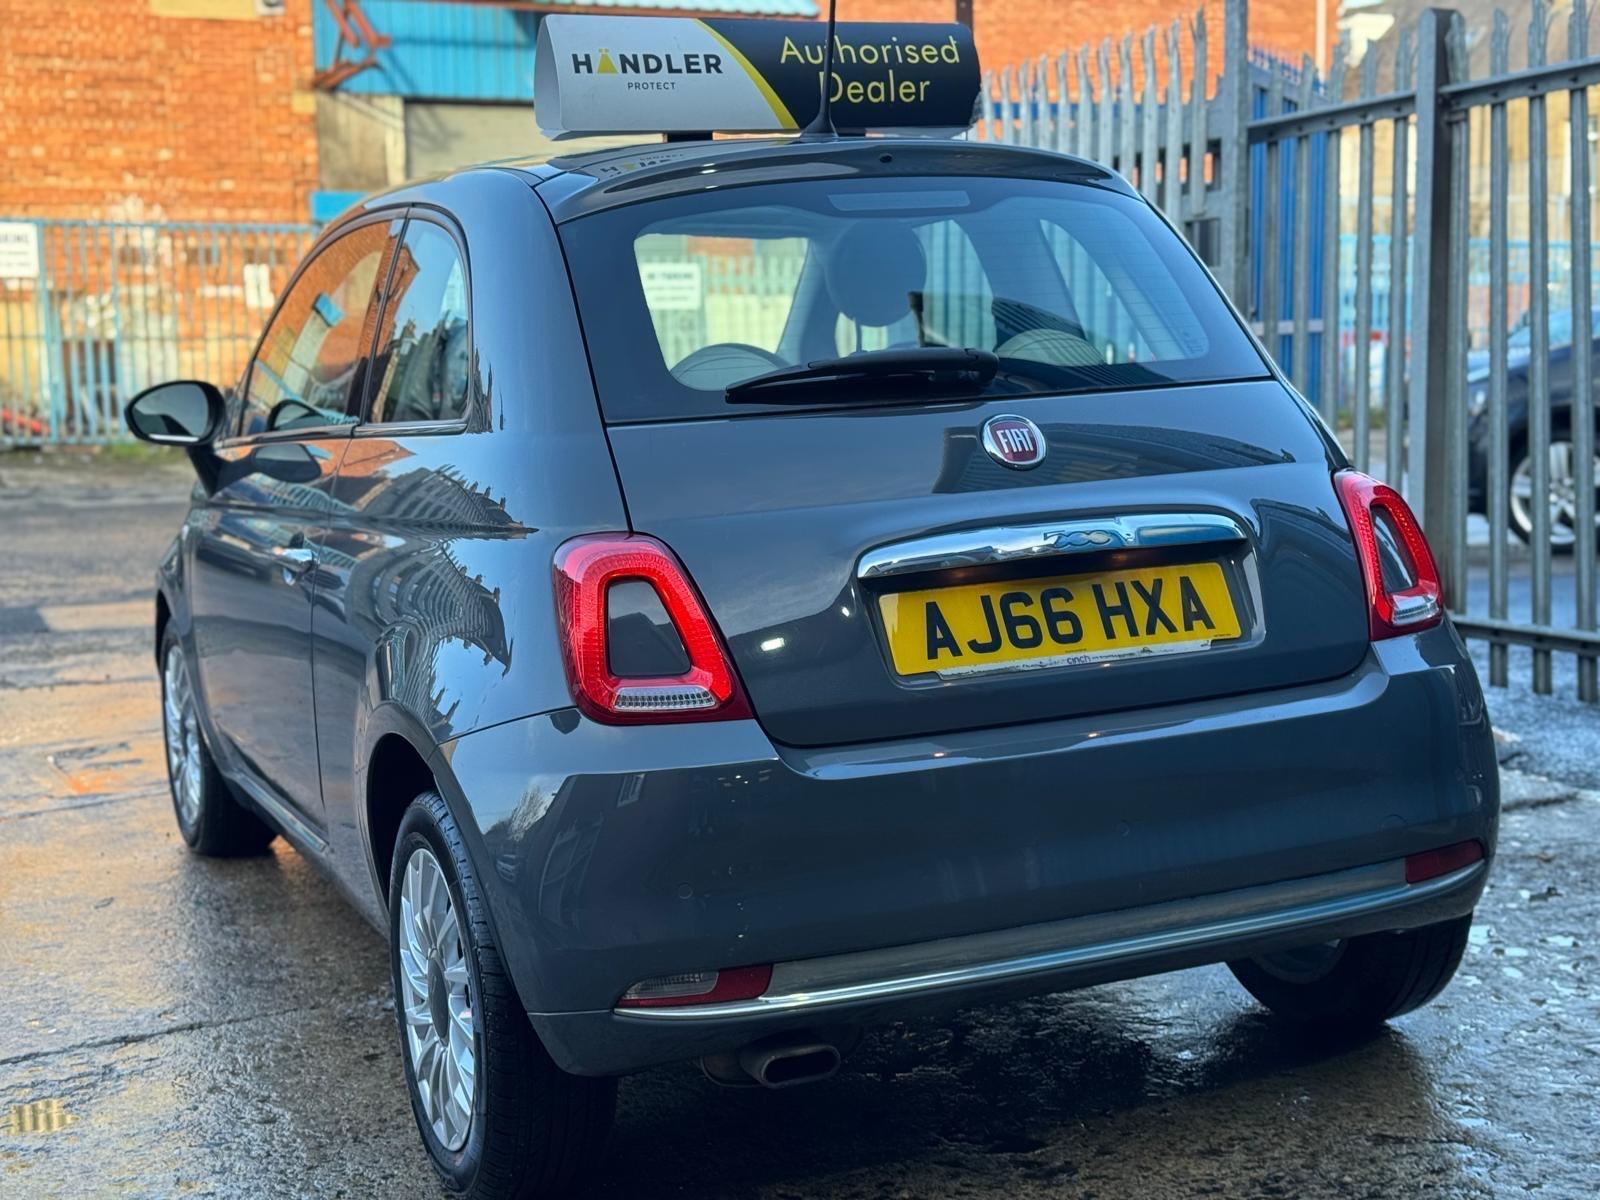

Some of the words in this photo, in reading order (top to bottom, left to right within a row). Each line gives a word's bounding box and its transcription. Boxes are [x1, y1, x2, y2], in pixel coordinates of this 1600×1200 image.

[572, 48, 724, 76] HÄNDLER
[780, 35, 961, 65] Auhorised
[627, 81, 676, 90] PROTECT
[819, 70, 931, 103] Dealer
[996, 428, 1034, 454] FIAT
[1043, 529, 1111, 549] 500
[926, 587, 1083, 661] AJ66
[1092, 576, 1216, 640] HXA
[1066, 654, 1091, 665] cinch
